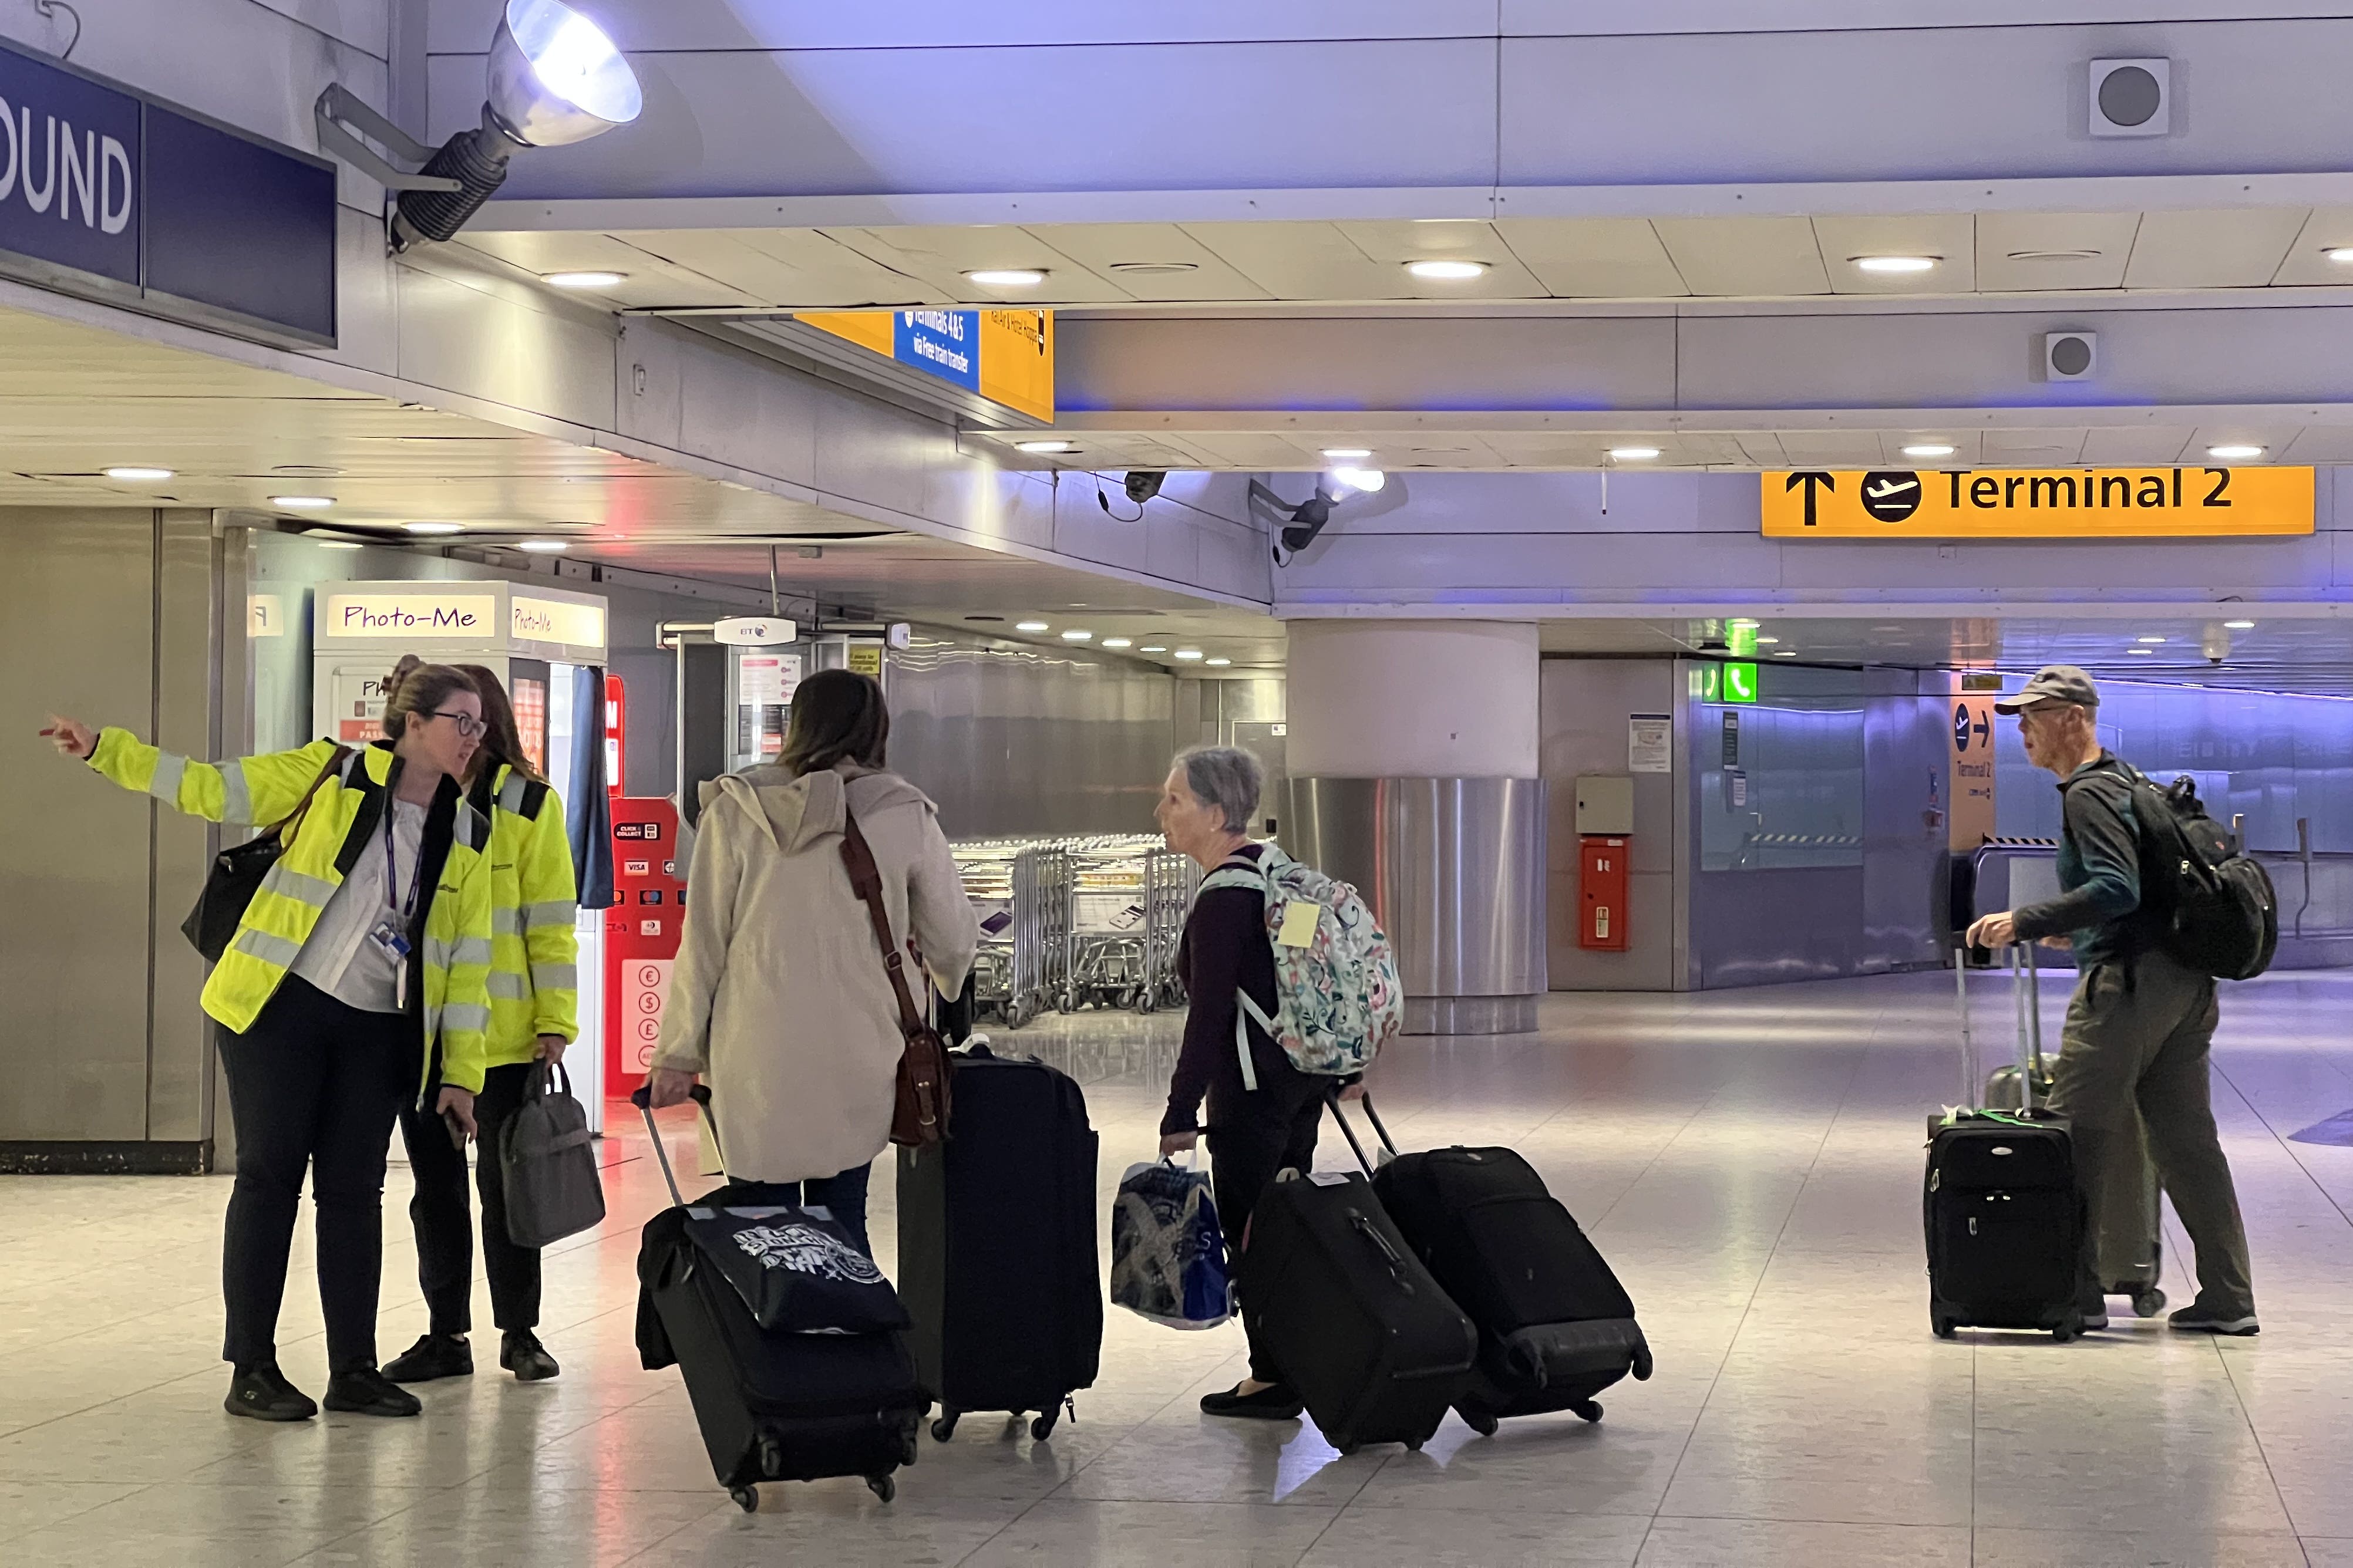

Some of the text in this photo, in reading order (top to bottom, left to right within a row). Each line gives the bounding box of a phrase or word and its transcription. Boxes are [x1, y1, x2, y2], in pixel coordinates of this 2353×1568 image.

[914, 332, 968, 373] via Free train transfer
[1940, 468, 2232, 508] Terminal 2
[345, 606, 476, 628] Photo-Me
[515, 608, 551, 632] Photo-Me
[1957, 761, 1991, 778] Terminal 2
